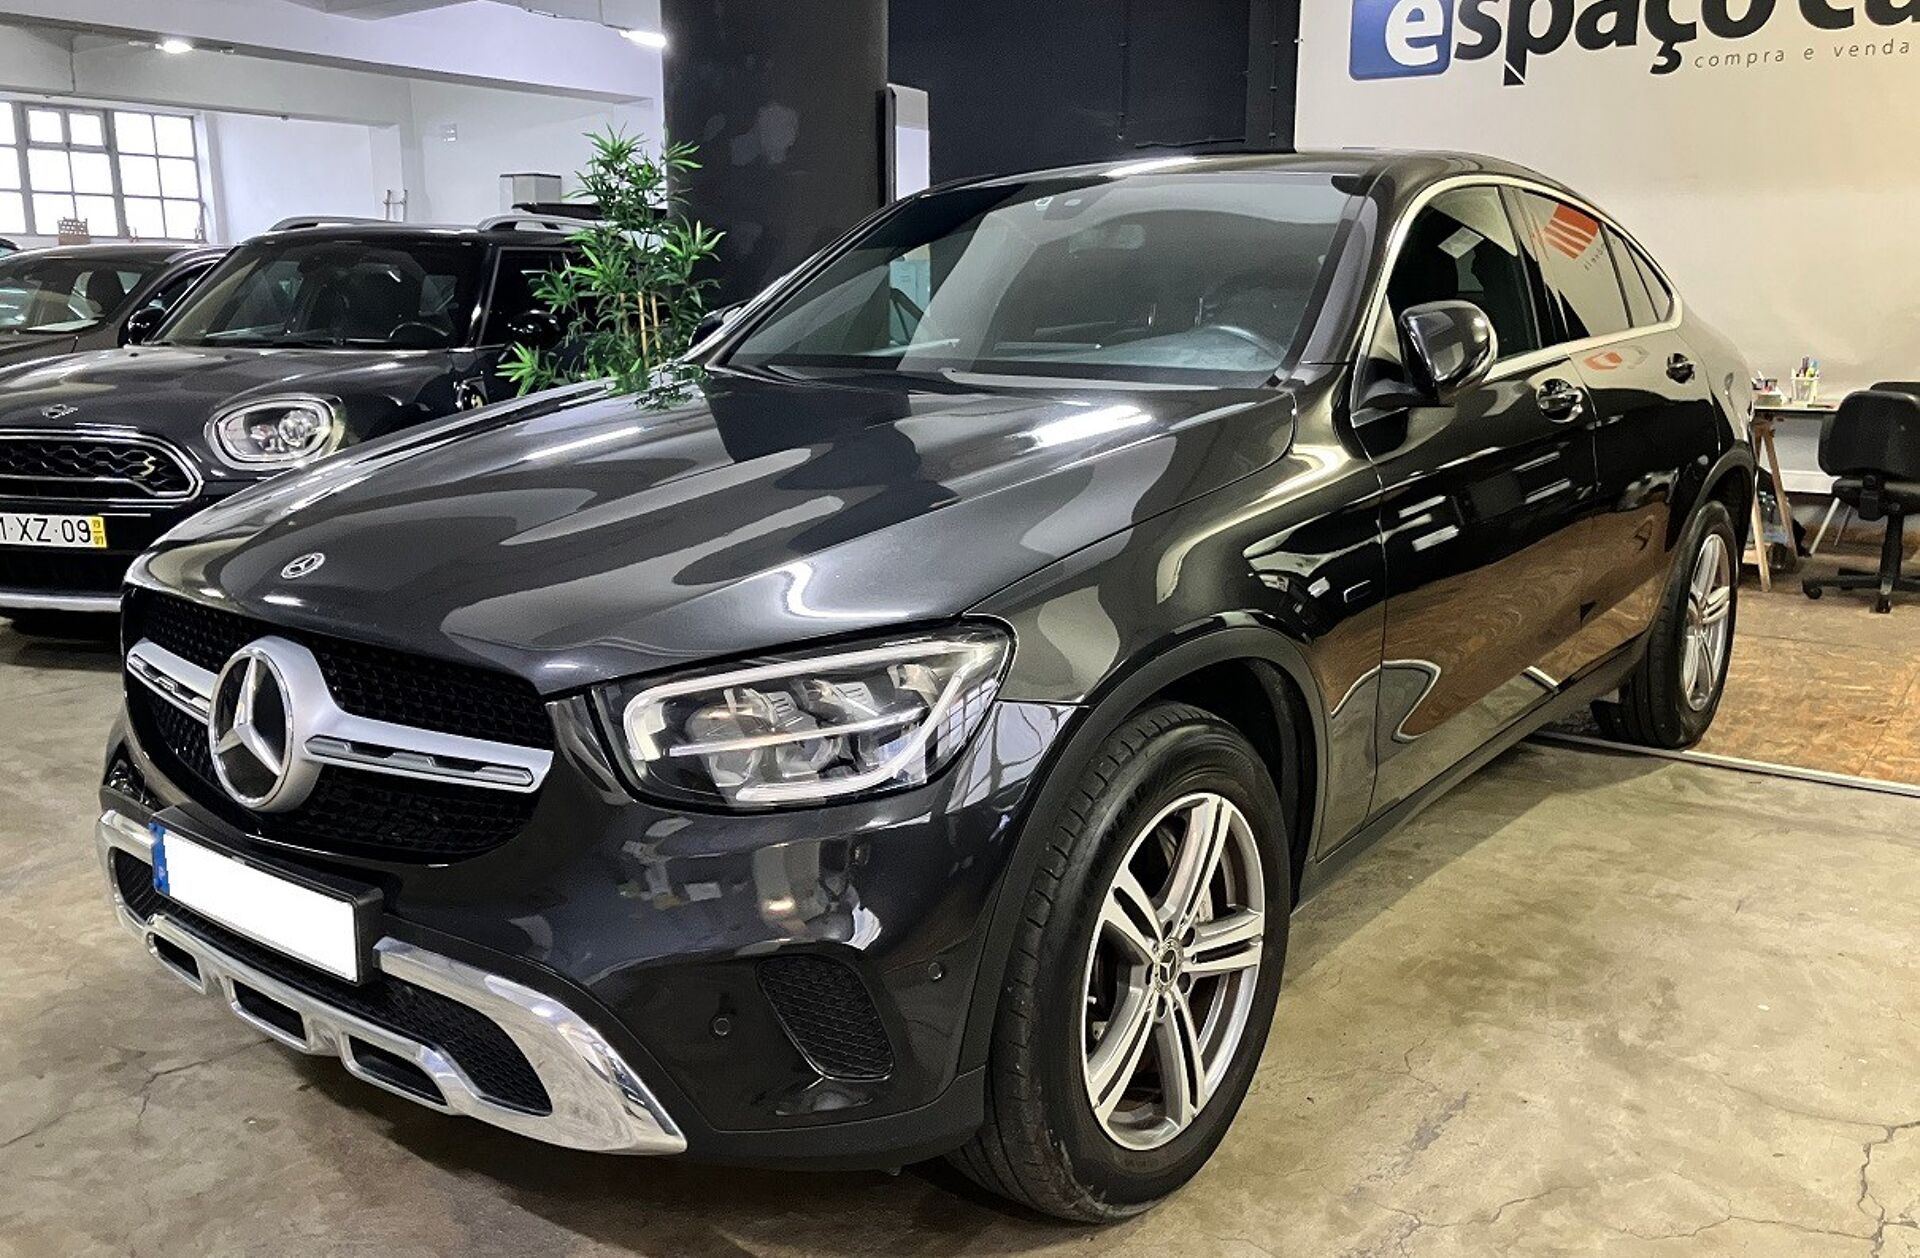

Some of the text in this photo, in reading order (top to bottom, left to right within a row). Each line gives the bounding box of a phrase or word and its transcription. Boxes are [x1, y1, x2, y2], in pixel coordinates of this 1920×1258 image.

[1694, 38, 1910, 68] compra e venda
